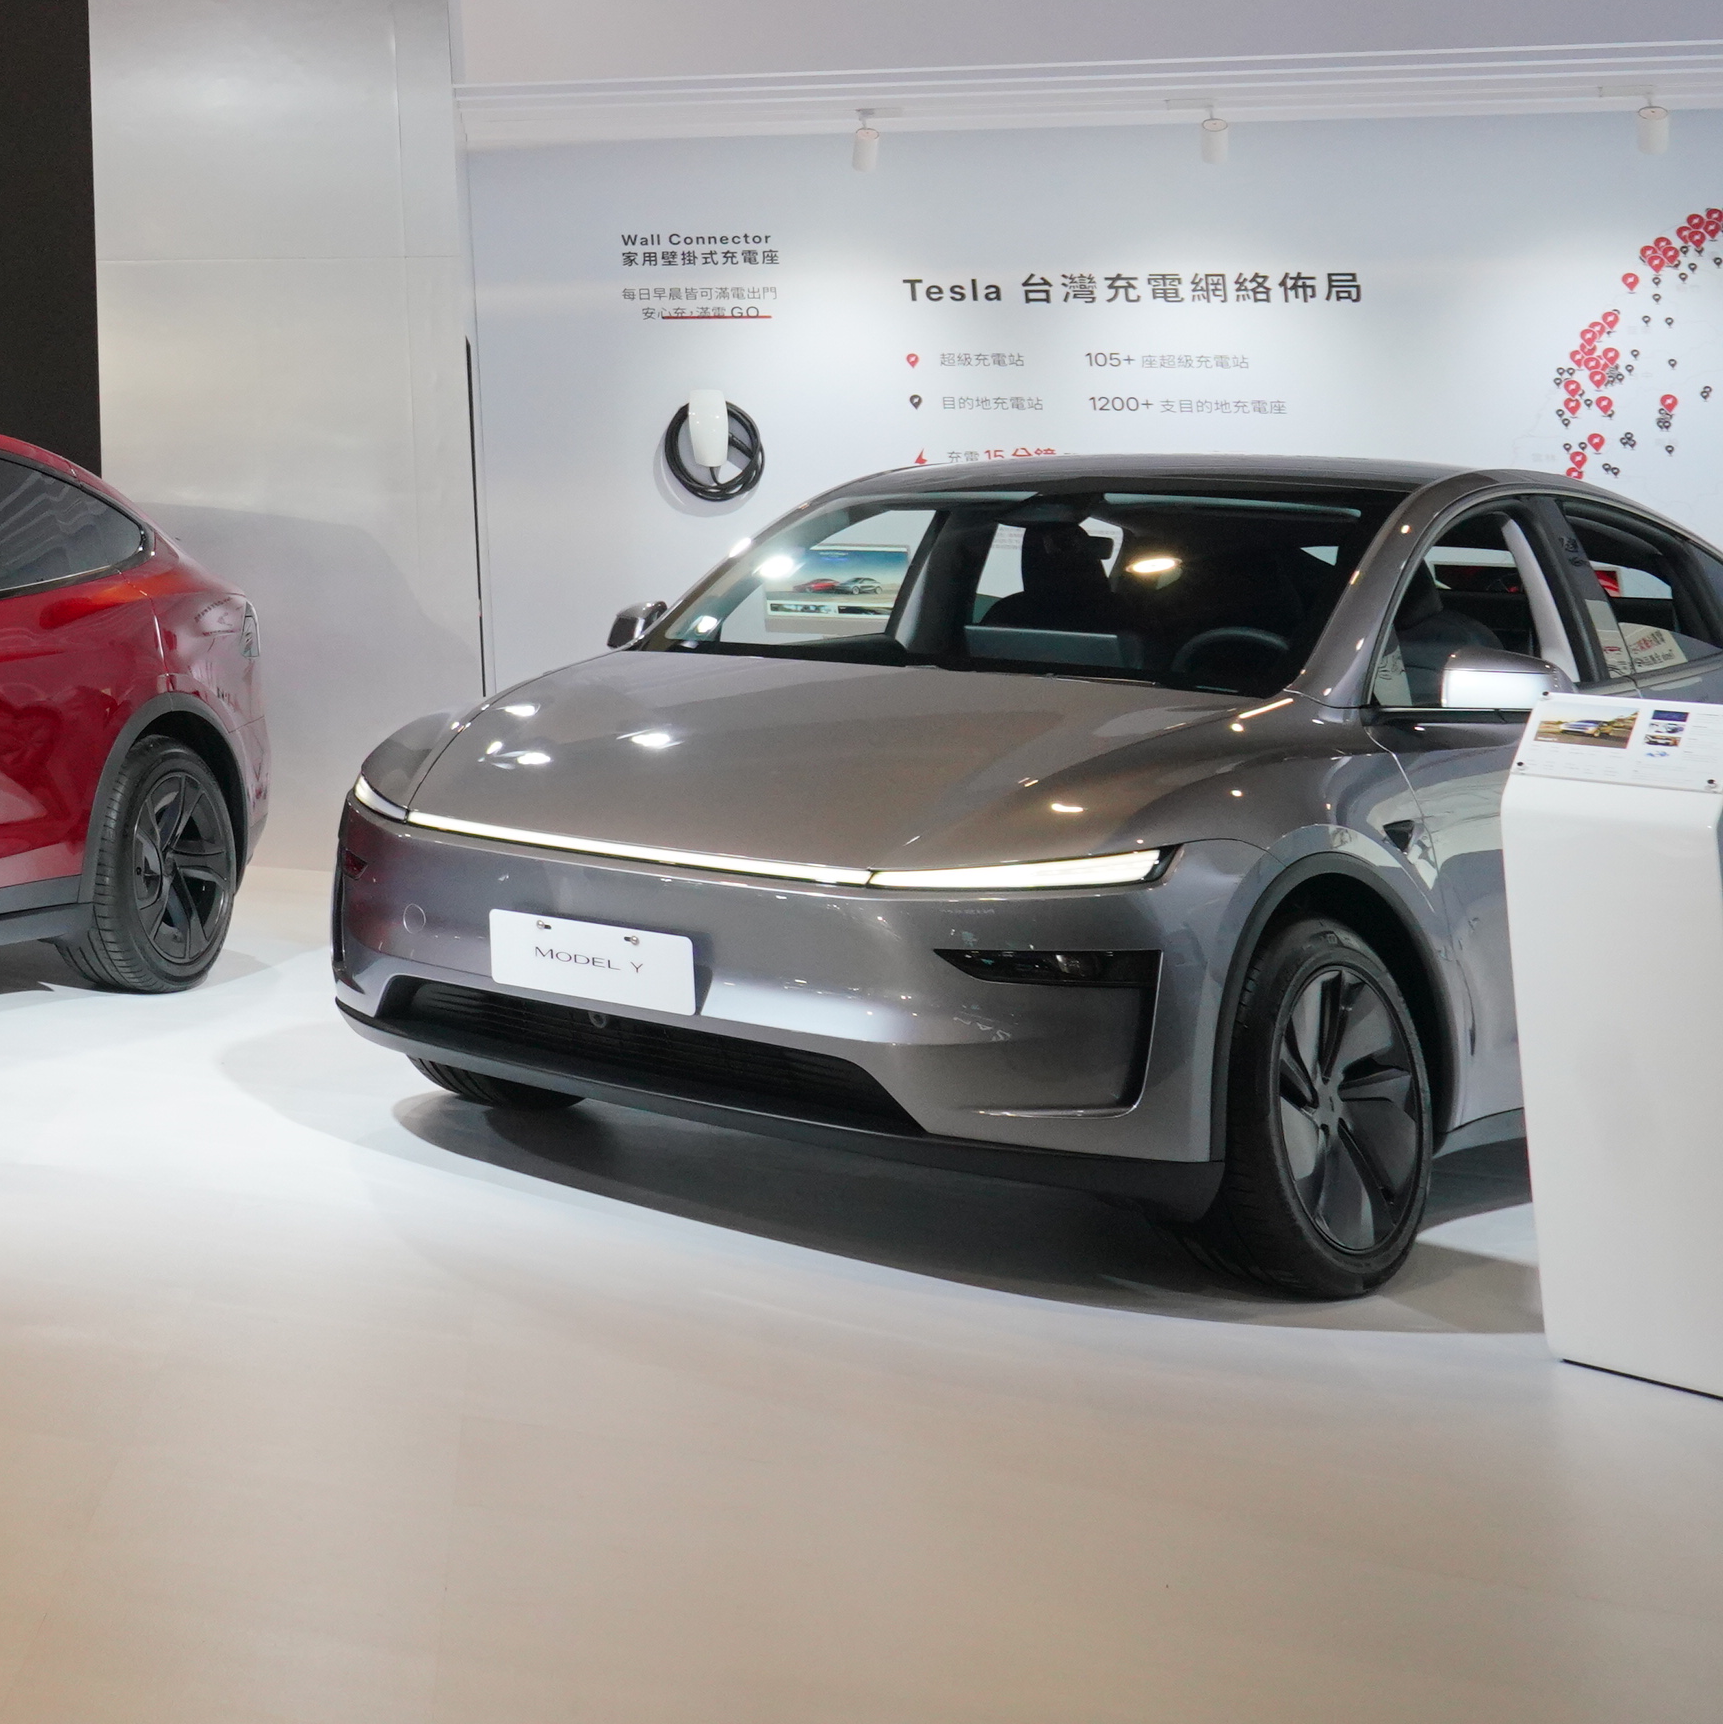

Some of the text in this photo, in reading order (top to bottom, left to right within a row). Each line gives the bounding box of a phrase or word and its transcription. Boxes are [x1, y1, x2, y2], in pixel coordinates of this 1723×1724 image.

[621, 233, 772, 246] Wall Connector
[621, 250, 780, 267] 家用壁掛式充電座
[621, 286, 778, 302] 每日早晨皆可滿電出門
[902, 271, 1363, 304] Tesla 台灣充電網絡佈局
[730, 306, 760, 318] GO
[940, 352, 1025, 368] 超級充電站
[1085, 352, 1250, 370] 105+ 座超級充電站
[942, 396, 1044, 412] 目的地充電站
[1088, 397, 1288, 415] 1200+ 支目的地充電座
[535, 946, 644, 974] MODEL Y
